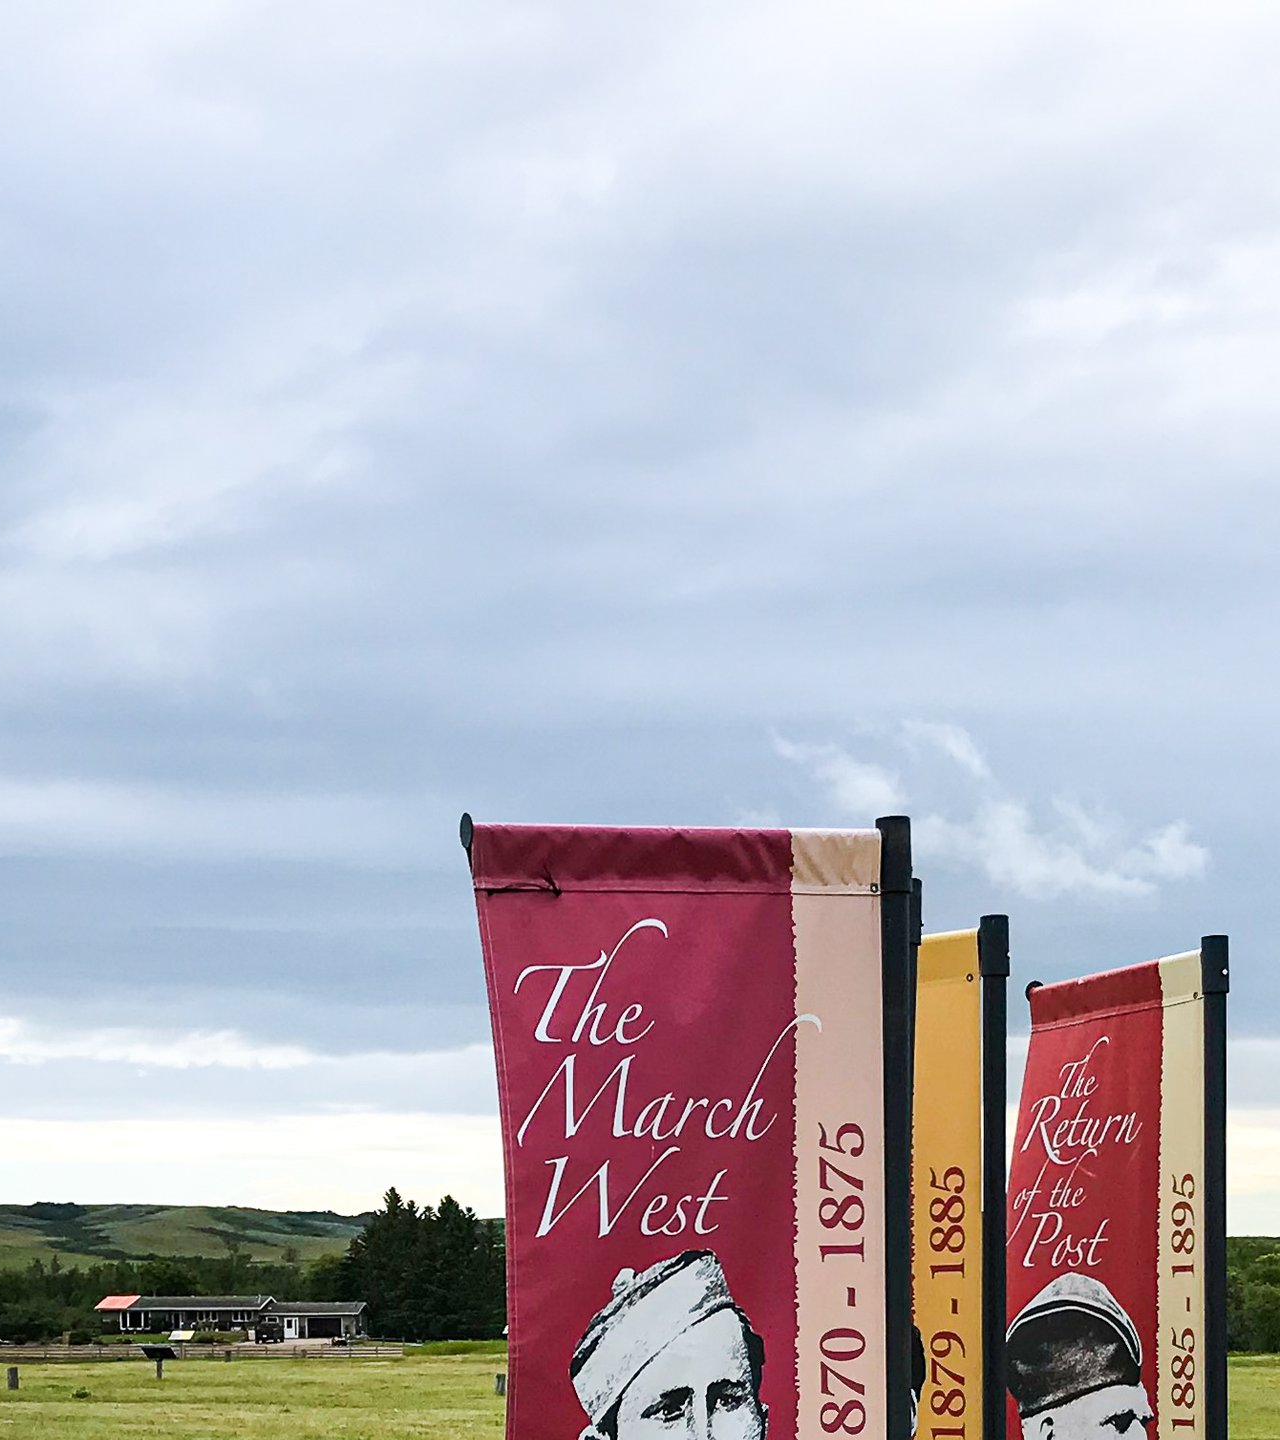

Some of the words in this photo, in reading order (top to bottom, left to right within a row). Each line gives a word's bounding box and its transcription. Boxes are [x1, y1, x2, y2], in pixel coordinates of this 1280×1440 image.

[514, 918, 669, 1045] The
[517, 1013, 822, 1148] March
[1058, 1036, 1111, 1099] The
[1020, 1095, 1144, 1166] Return
[535, 1146, 728, 1239] West
[818, 1121, 865, 1263] 1875
[929, 1165, 966, 1280] 1885
[1006, 1149, 1061, 1247] of
[1048, 1148, 1098, 1209] the
[1022, 1211, 1110, 1268] Post
[1171, 1172, 1196, 1279] 1895
[846, 1286, 857, 1308] -
[950, 1297, 959, 1315] -
[1186, 1296, 1191, 1313] -
[1171, 1327, 1196, 1432] 1885
